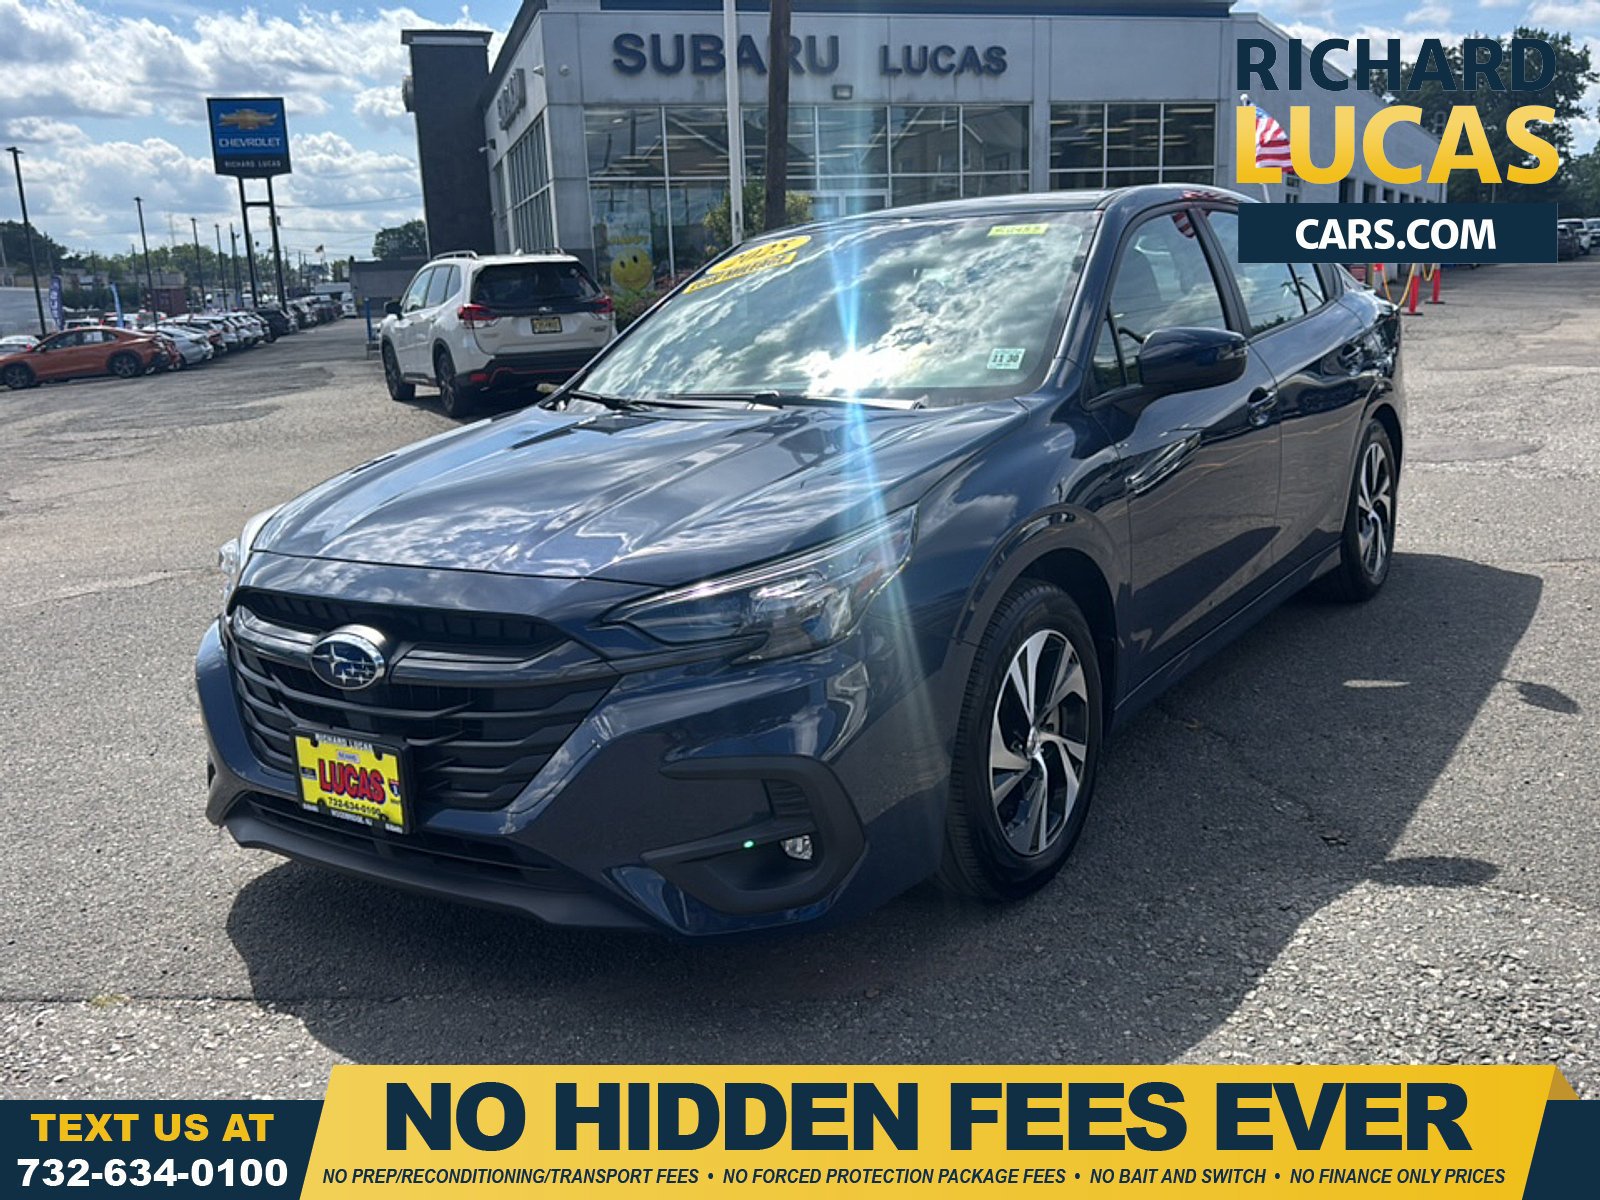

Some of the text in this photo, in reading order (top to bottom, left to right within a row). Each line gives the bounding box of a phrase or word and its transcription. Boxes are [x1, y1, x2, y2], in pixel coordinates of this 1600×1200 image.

[612, 33, 839, 75] SUBARU
[879, 45, 1008, 76] LUCAS
[219, 137, 281, 148] CHEVROLET
[318, 759, 386, 804] LUCAS
